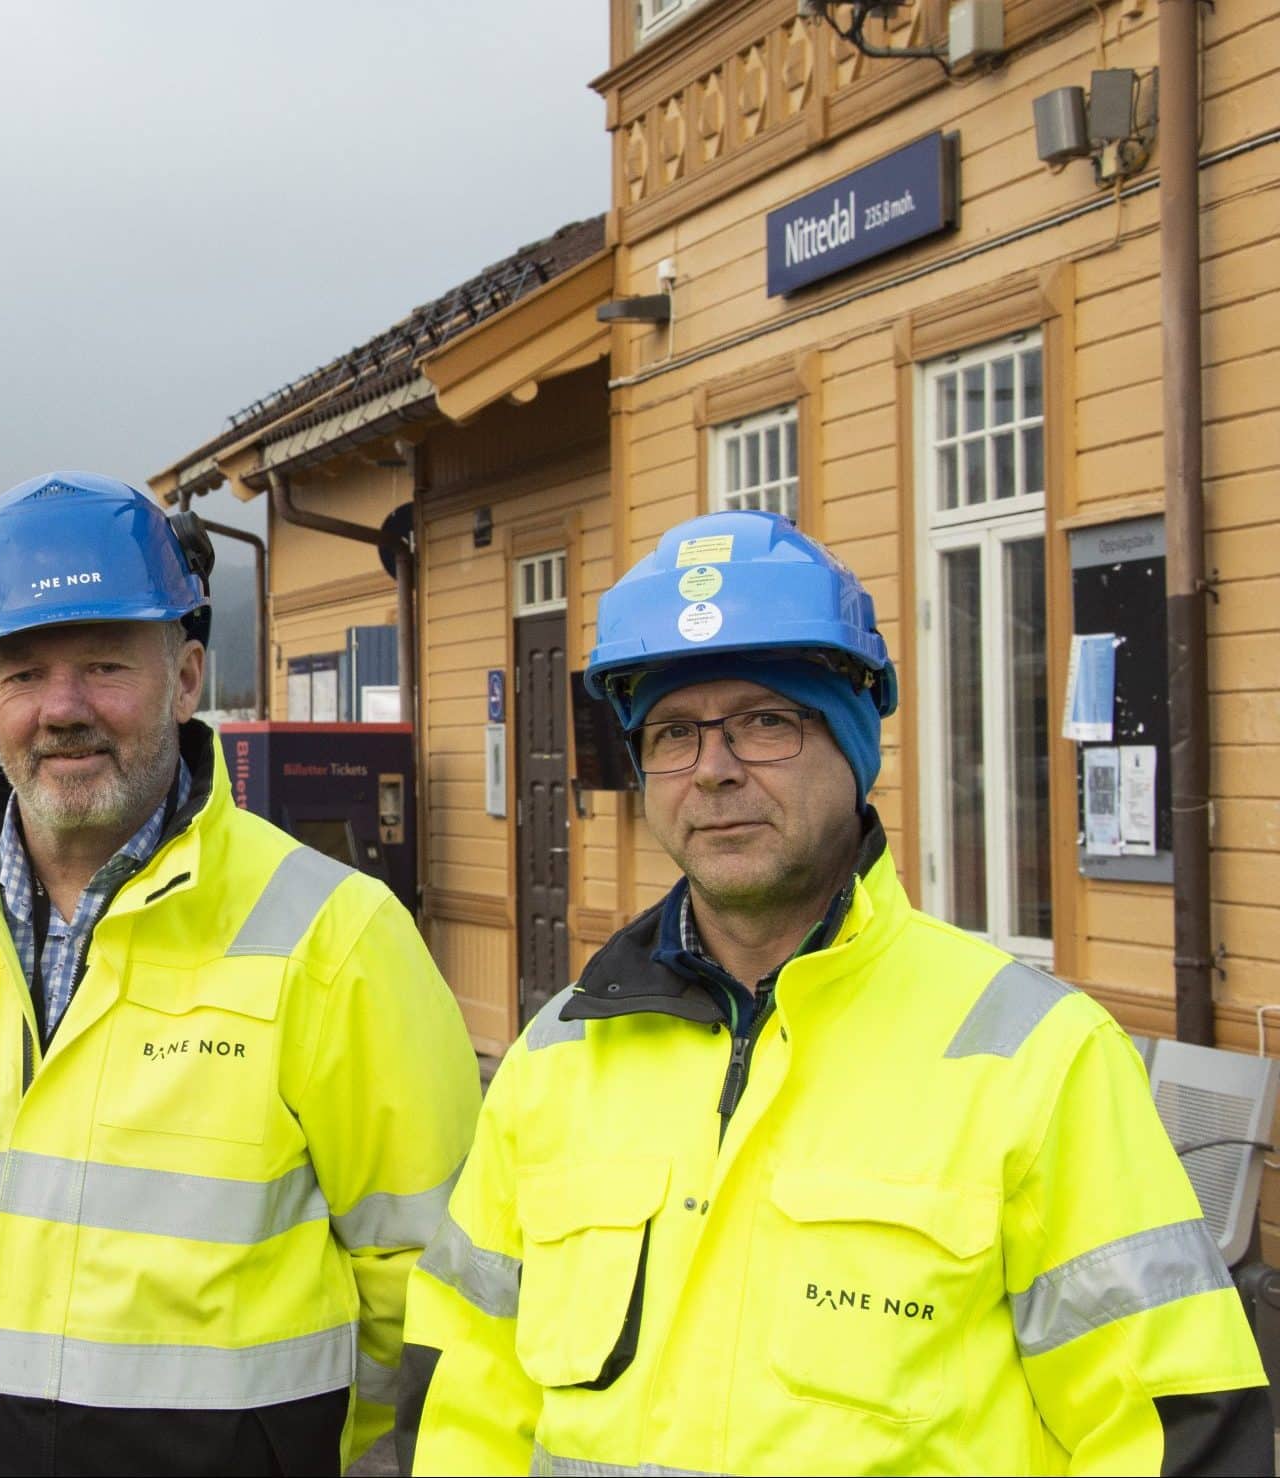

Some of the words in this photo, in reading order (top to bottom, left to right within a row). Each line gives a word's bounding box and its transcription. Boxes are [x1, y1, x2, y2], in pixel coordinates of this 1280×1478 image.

[785, 190, 855, 268] Nittedal
[864, 199, 890, 230] 235,8
[890, 188, 917, 219] moh.
[66, 572, 102, 586] NOR
[330, 762, 368, 776] Tickets
[143, 1040, 189, 1061] BANE
[199, 1039, 245, 1057] NOR
[806, 1283, 871, 1311] BANE
[884, 1297, 935, 1320] NOR
